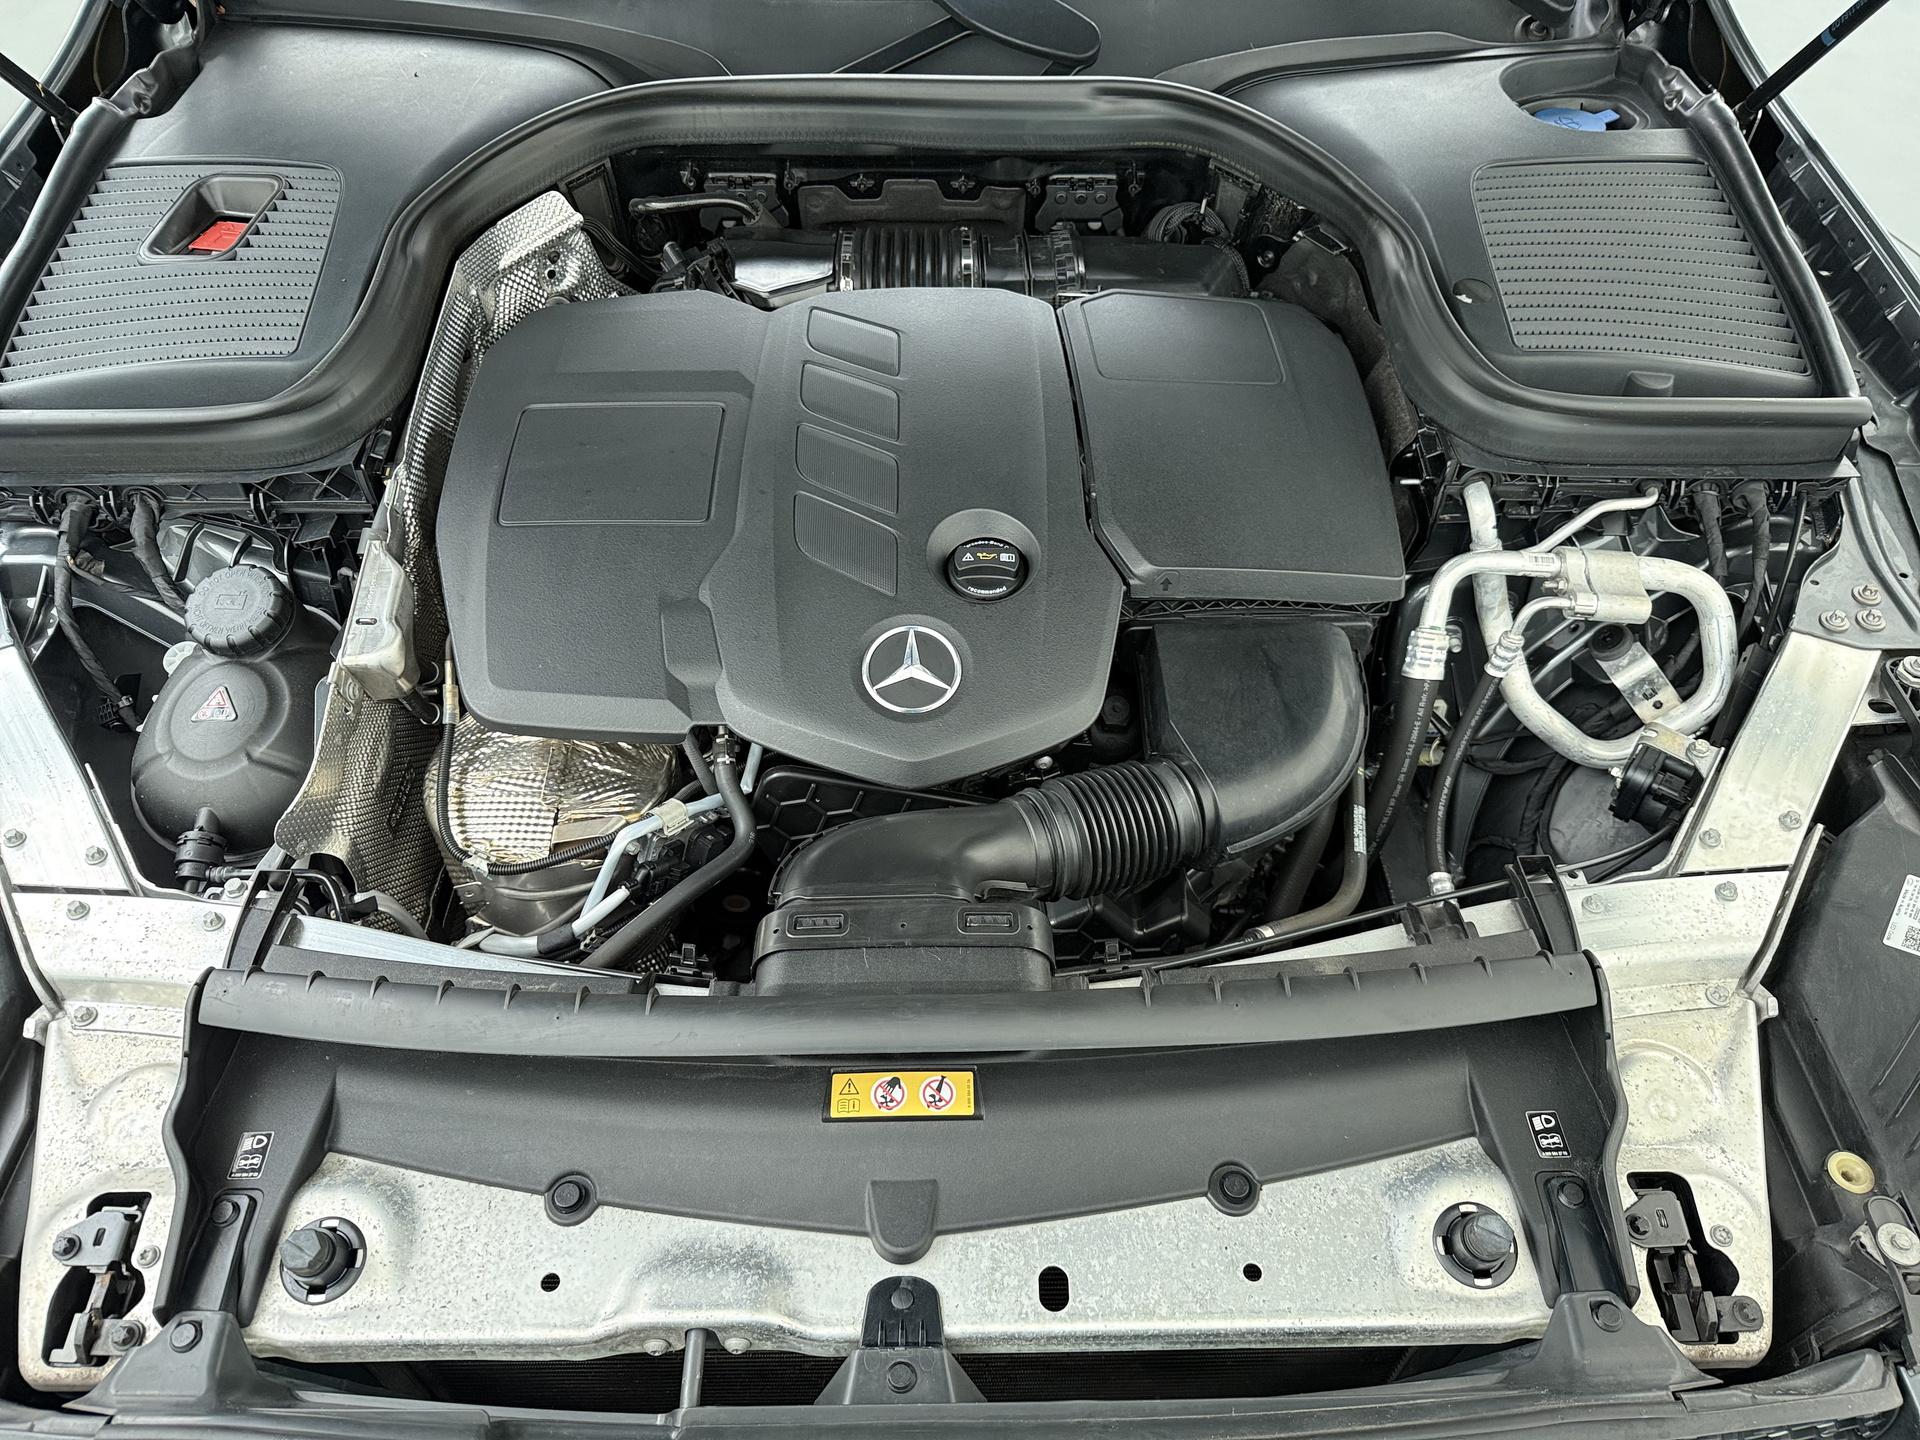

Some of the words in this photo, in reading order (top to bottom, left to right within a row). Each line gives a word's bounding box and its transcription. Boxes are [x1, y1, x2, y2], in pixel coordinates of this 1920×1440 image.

[963, 540, 1004, 548] ercedes-Benz
[224, 568, 245, 579] OPEN
[967, 585, 1007, 594] recommended
